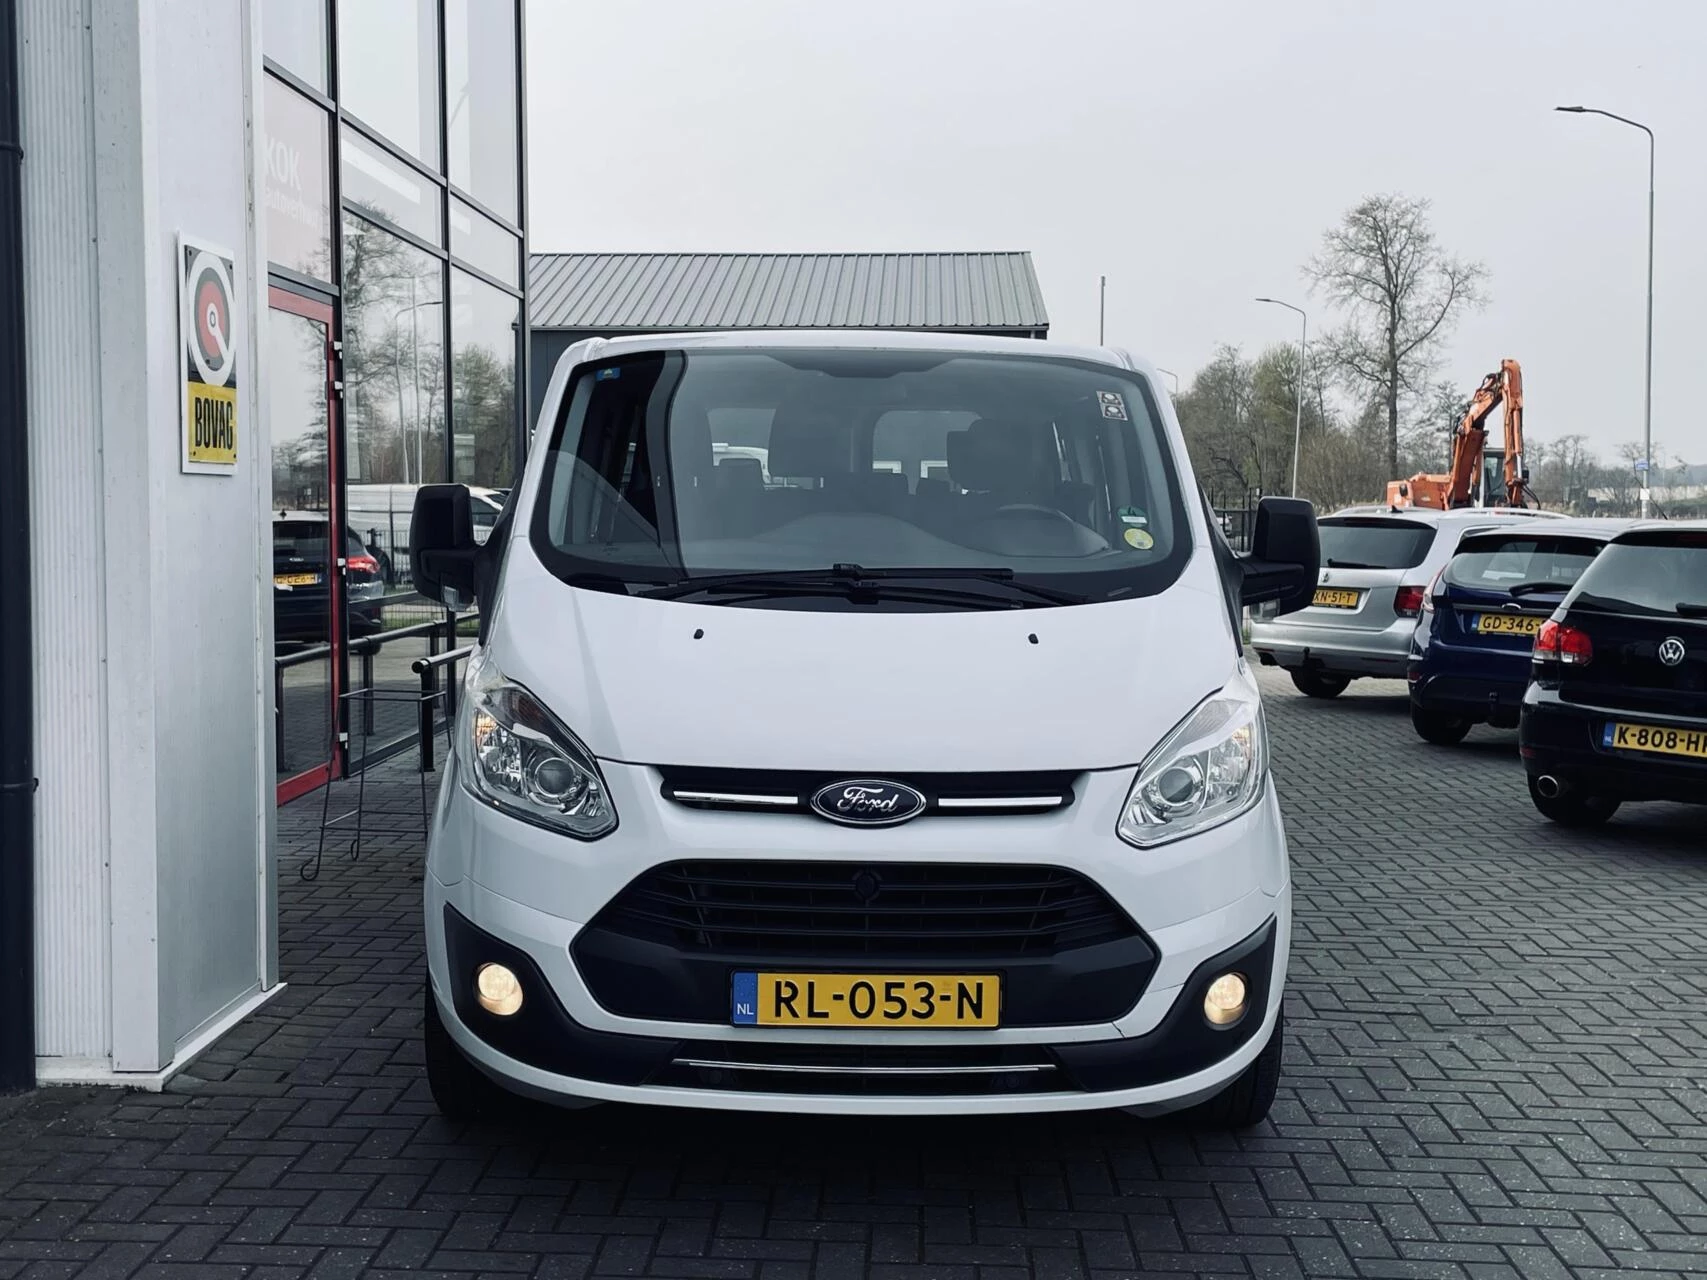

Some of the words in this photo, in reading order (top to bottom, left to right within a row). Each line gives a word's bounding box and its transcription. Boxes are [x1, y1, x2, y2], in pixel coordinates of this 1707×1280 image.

[195, 397, 233, 450] BOVAG
[1483, 616, 1546, 631] GD-346-
[837, 786, 899, 812] Ford
[736, 1003, 754, 1016] NL
[774, 980, 984, 1020] RL-053-N
